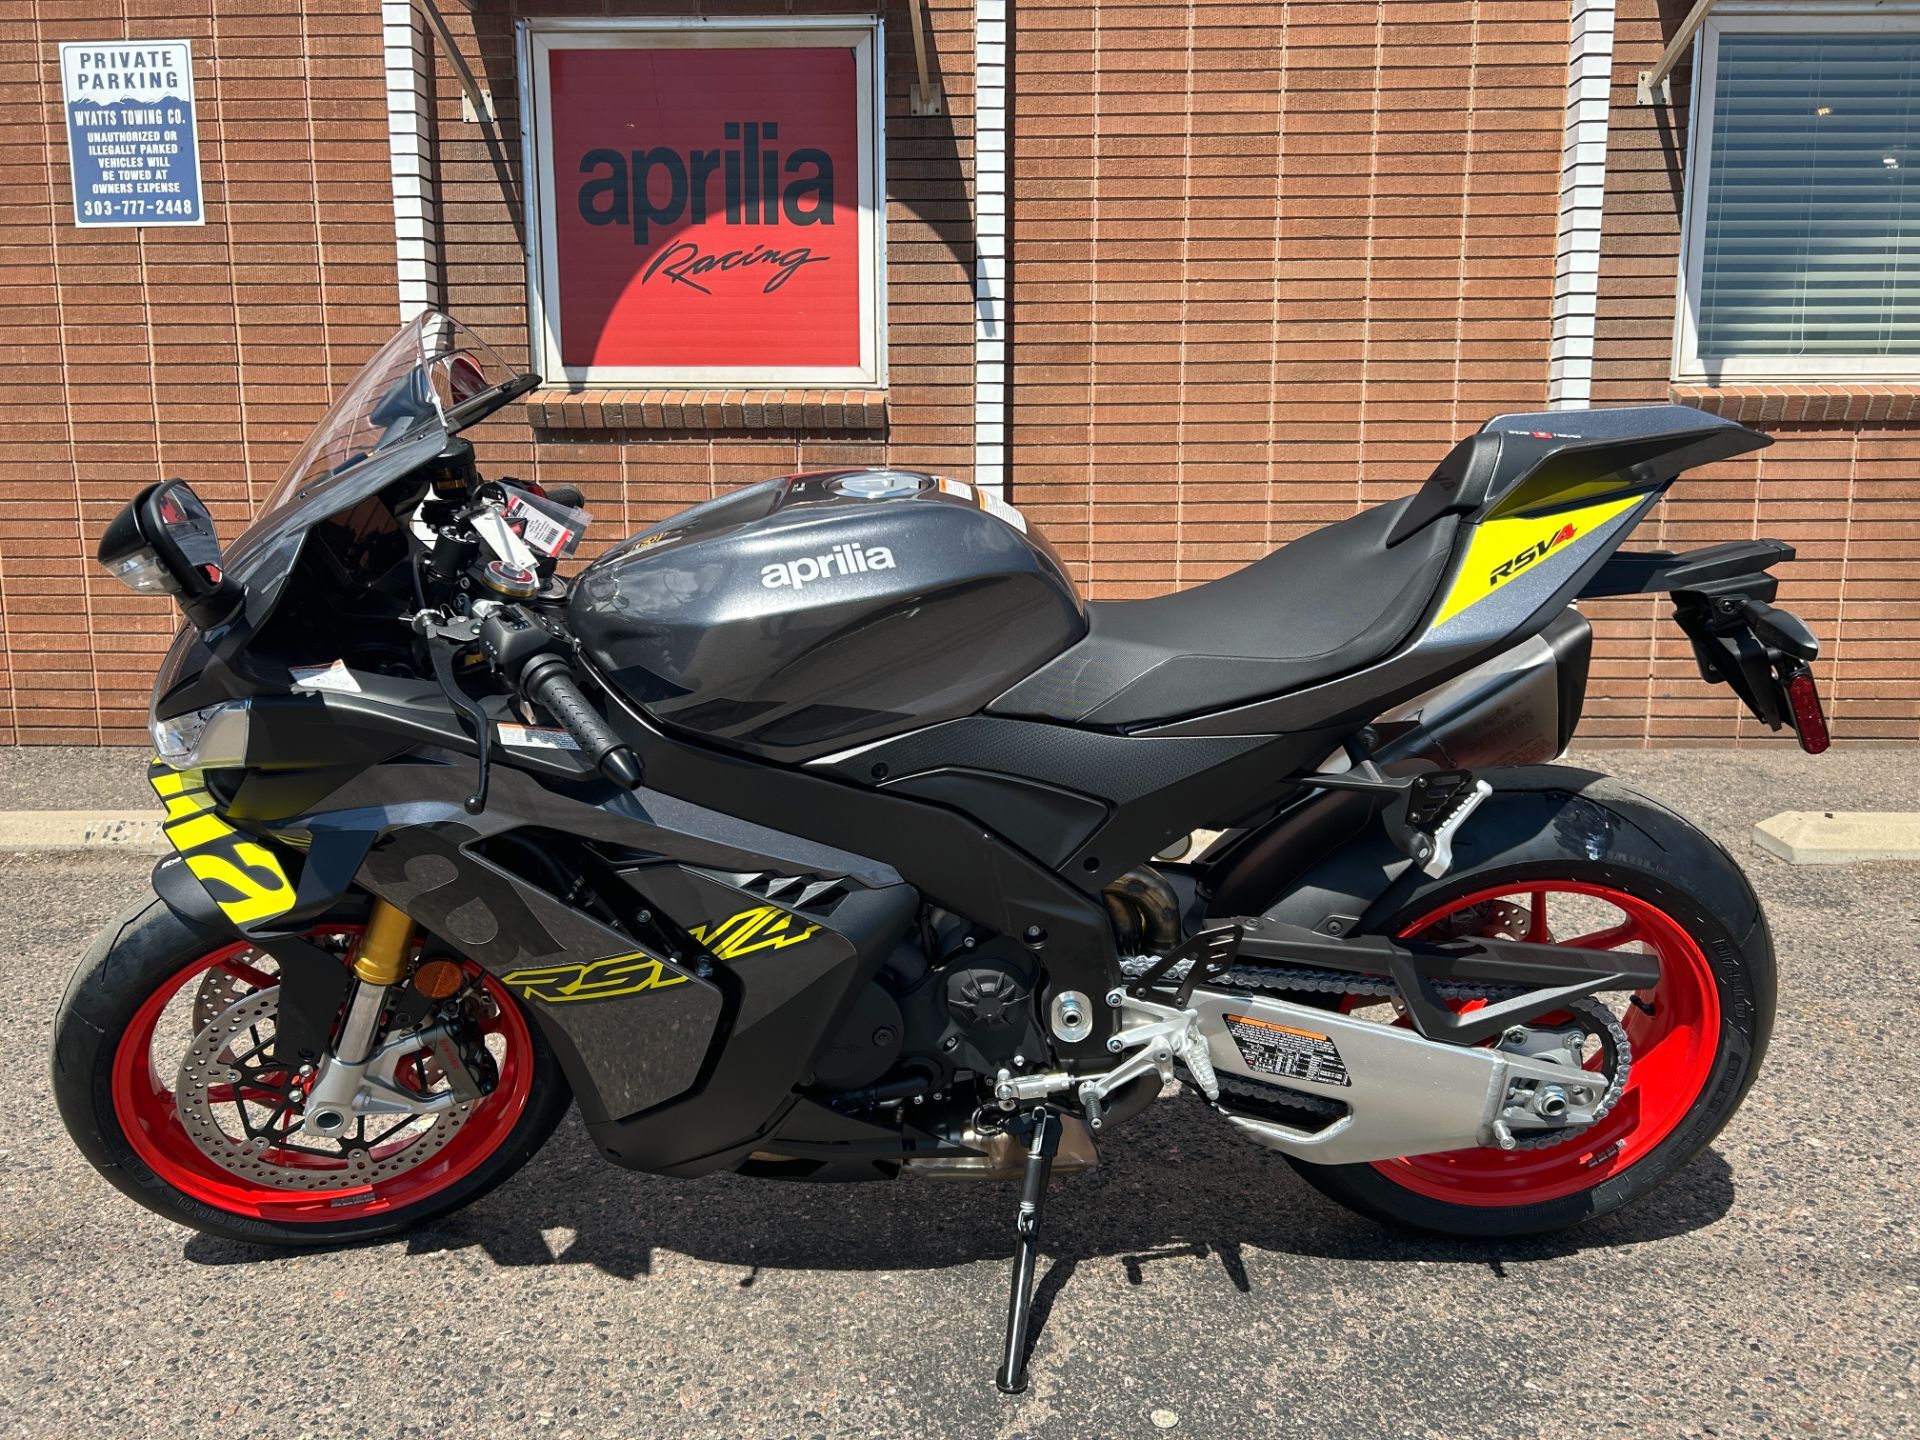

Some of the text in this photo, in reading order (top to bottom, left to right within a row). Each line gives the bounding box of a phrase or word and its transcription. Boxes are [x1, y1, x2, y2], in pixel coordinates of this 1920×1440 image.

[79, 50, 174, 70] PRIVATE
[77, 71, 179, 90] PARKING
[74, 108, 186, 127] WYATTS TOWING CO.
[87, 130, 178, 143] UNAUTHORIZED OR
[88, 143, 178, 156] ILLEGALLY PARKED
[98, 156, 171, 169] VEHICLES WILL
[102, 169, 168, 182] BE TOWED AT
[577, 121, 836, 246] aprilia
[92, 182, 181, 195] OWNERS EXPENSE
[84, 199, 193, 217] 303-777-2448
[641, 239, 831, 295] Racing
[1489, 523, 1579, 586] RSV4
[760, 541, 897, 590] aprilia
